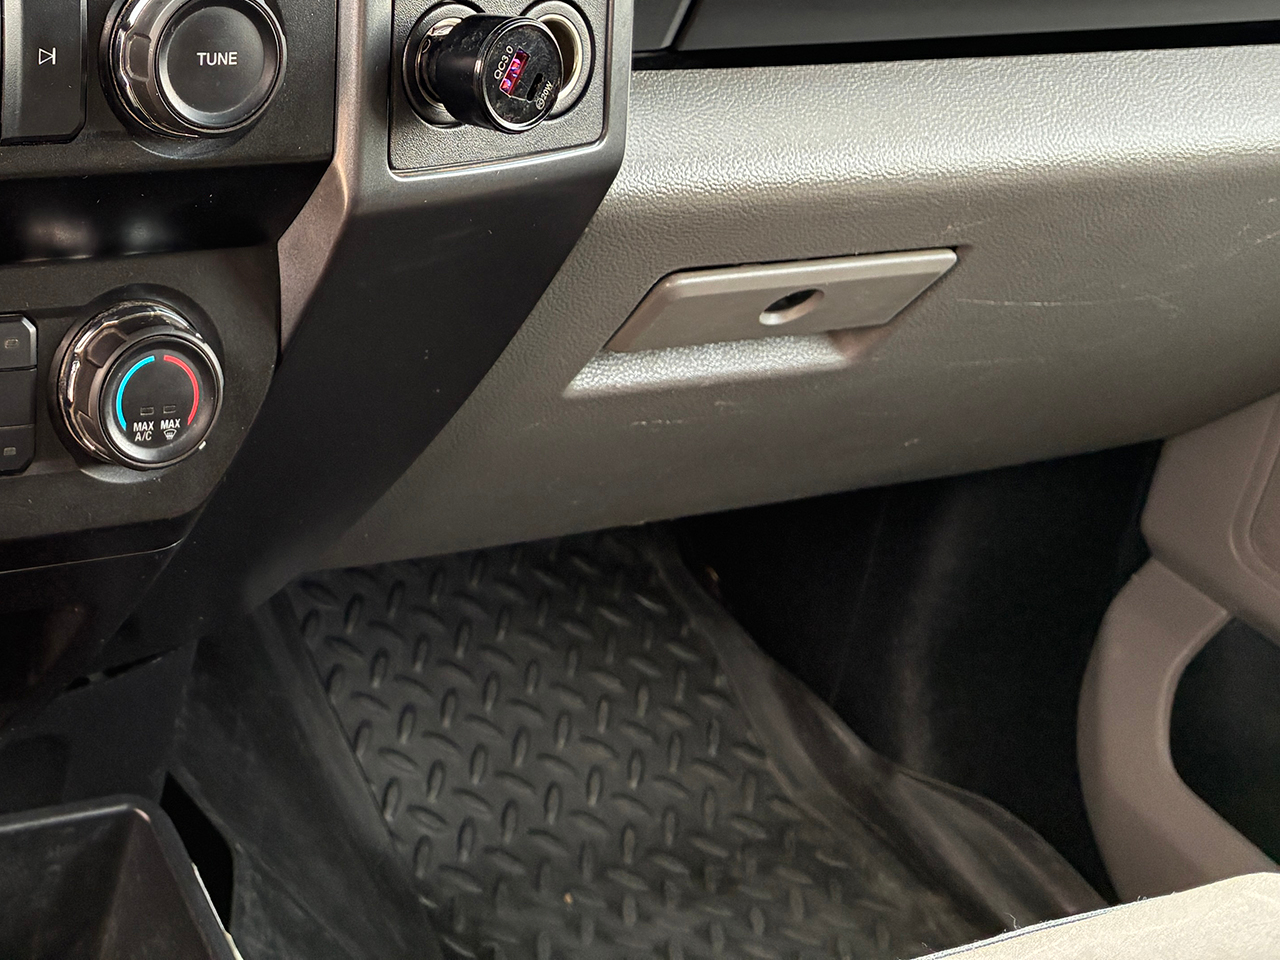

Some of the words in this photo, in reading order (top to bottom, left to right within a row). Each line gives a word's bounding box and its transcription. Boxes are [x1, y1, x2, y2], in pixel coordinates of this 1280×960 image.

[196, 51, 238, 66] TUNE
[493, 45, 514, 81] QC3.0
[133, 421, 155, 432] MAX
[160, 418, 181, 431] MAX
[134, 431, 153, 442] A/C
